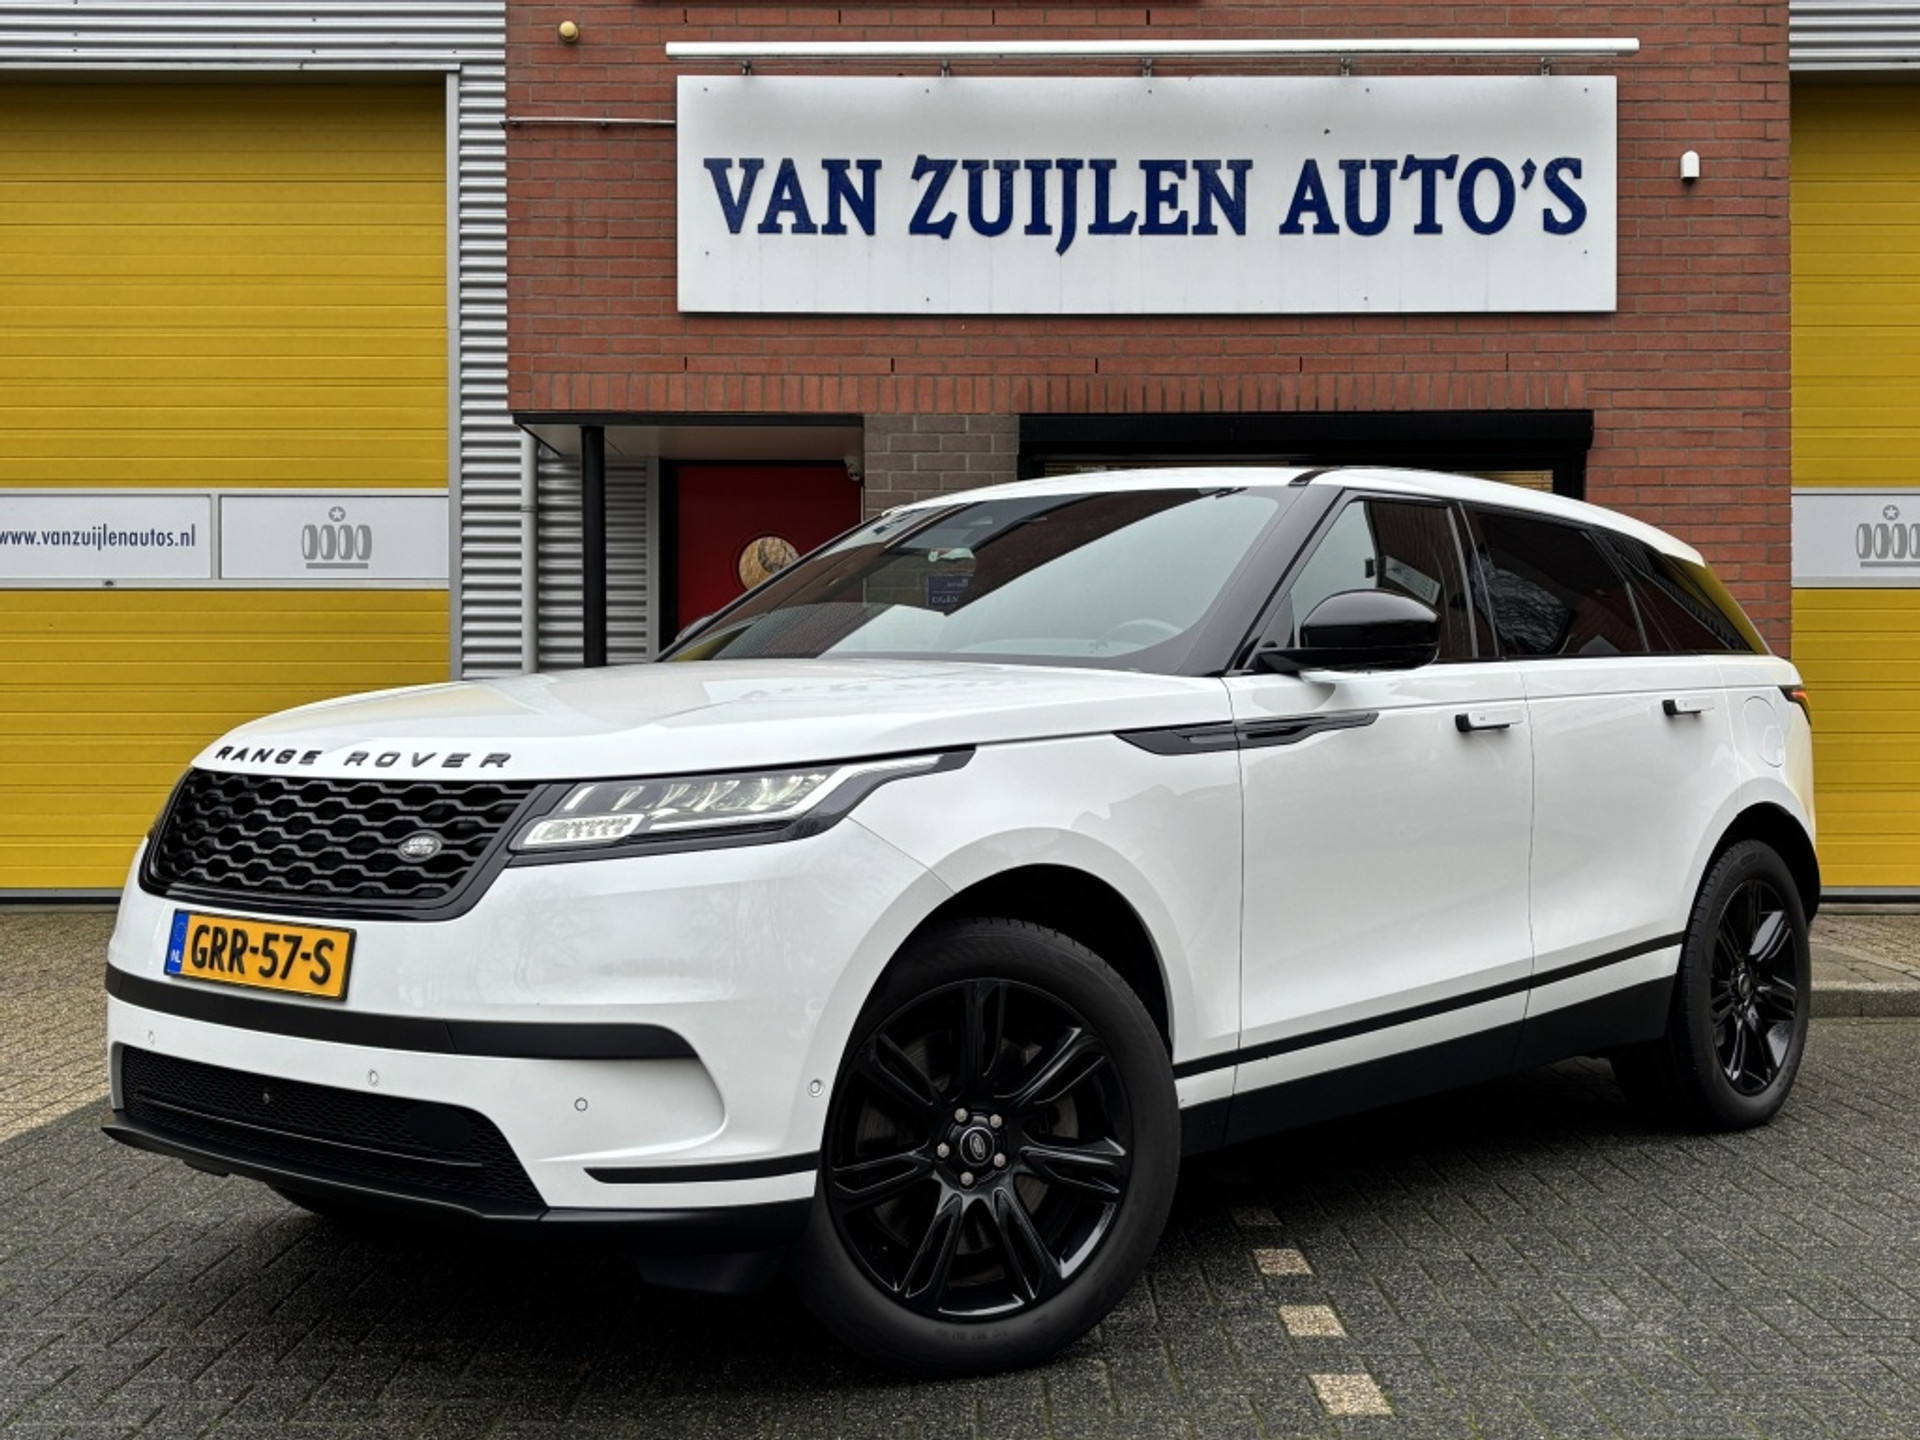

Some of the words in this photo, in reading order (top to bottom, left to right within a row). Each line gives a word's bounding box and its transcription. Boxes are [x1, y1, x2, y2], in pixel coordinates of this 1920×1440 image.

[703, 158, 882, 236] VAN
[908, 154, 1254, 256] ZUIJLEN
[1278, 154, 1587, 236] AUTO'S
[214, 745, 323, 765] RANGE
[343, 751, 512, 769] ROVER
[170, 949, 181, 963] NL
[191, 924, 335, 986] GRR-57-S
